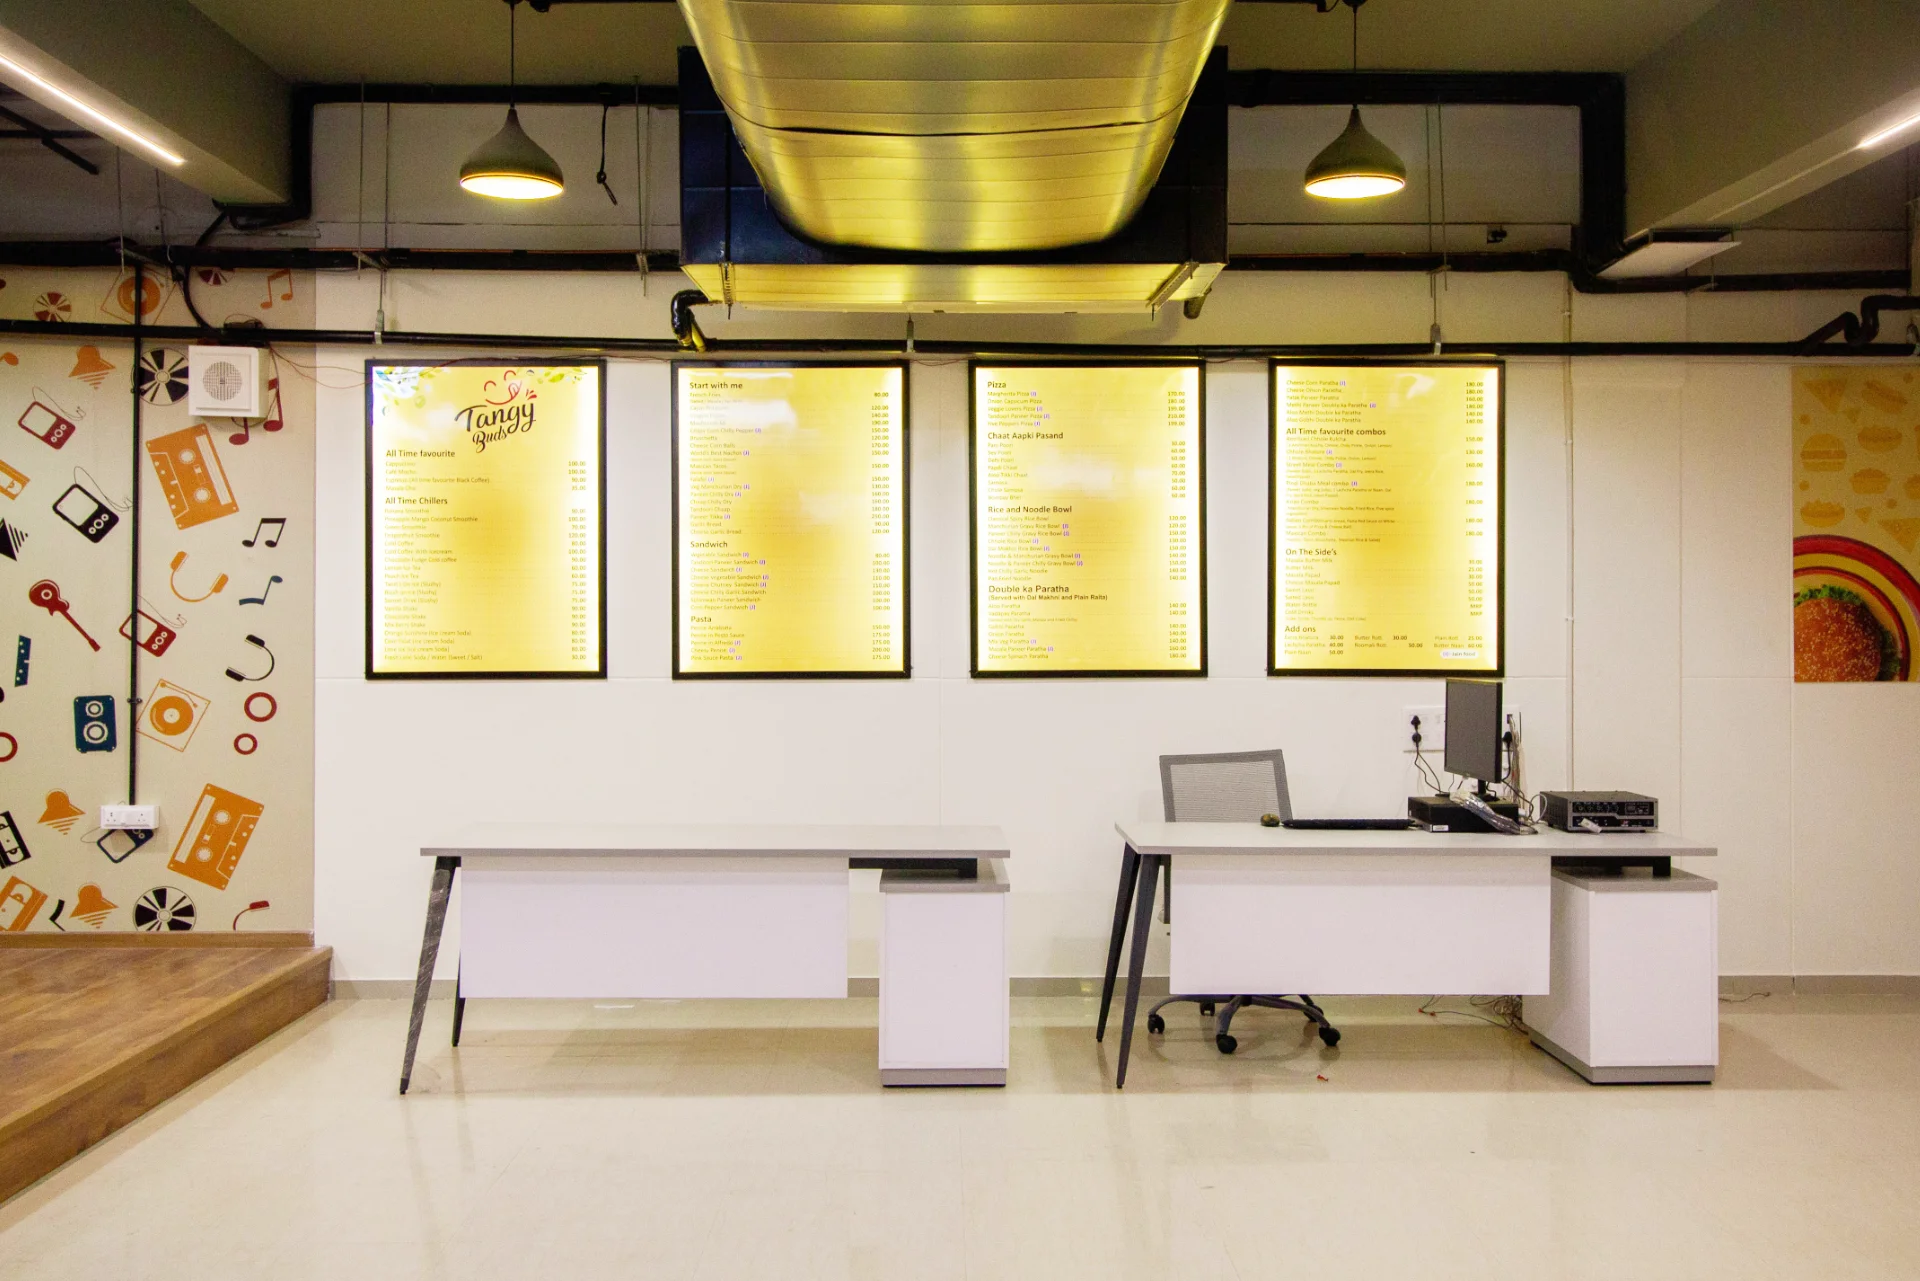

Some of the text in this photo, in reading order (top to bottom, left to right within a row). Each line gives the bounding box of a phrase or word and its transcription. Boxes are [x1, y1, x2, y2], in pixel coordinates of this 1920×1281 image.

[690, 380, 708, 389] Start
[710, 380, 728, 389] with
[987, 380, 1007, 389] Pizza
[454, 402, 536, 434] Tangy
[1286, 427, 1386, 435] All Time favourite combos
[472, 427, 507, 453] Buds
[988, 431, 1064, 441] Chaat Aapki Pasand
[386, 449, 456, 458] All Time favourite
[385, 496, 448, 505] All Time Chillers
[988, 505, 1072, 513] Rice and Noodle Bowl
[690, 539, 728, 548] Sandwich
[1286, 547, 1337, 556] On The Side's
[988, 584, 1069, 593] Double ka Paratha
[691, 614, 712, 623] Pasta
[1285, 624, 1300, 633] Add
